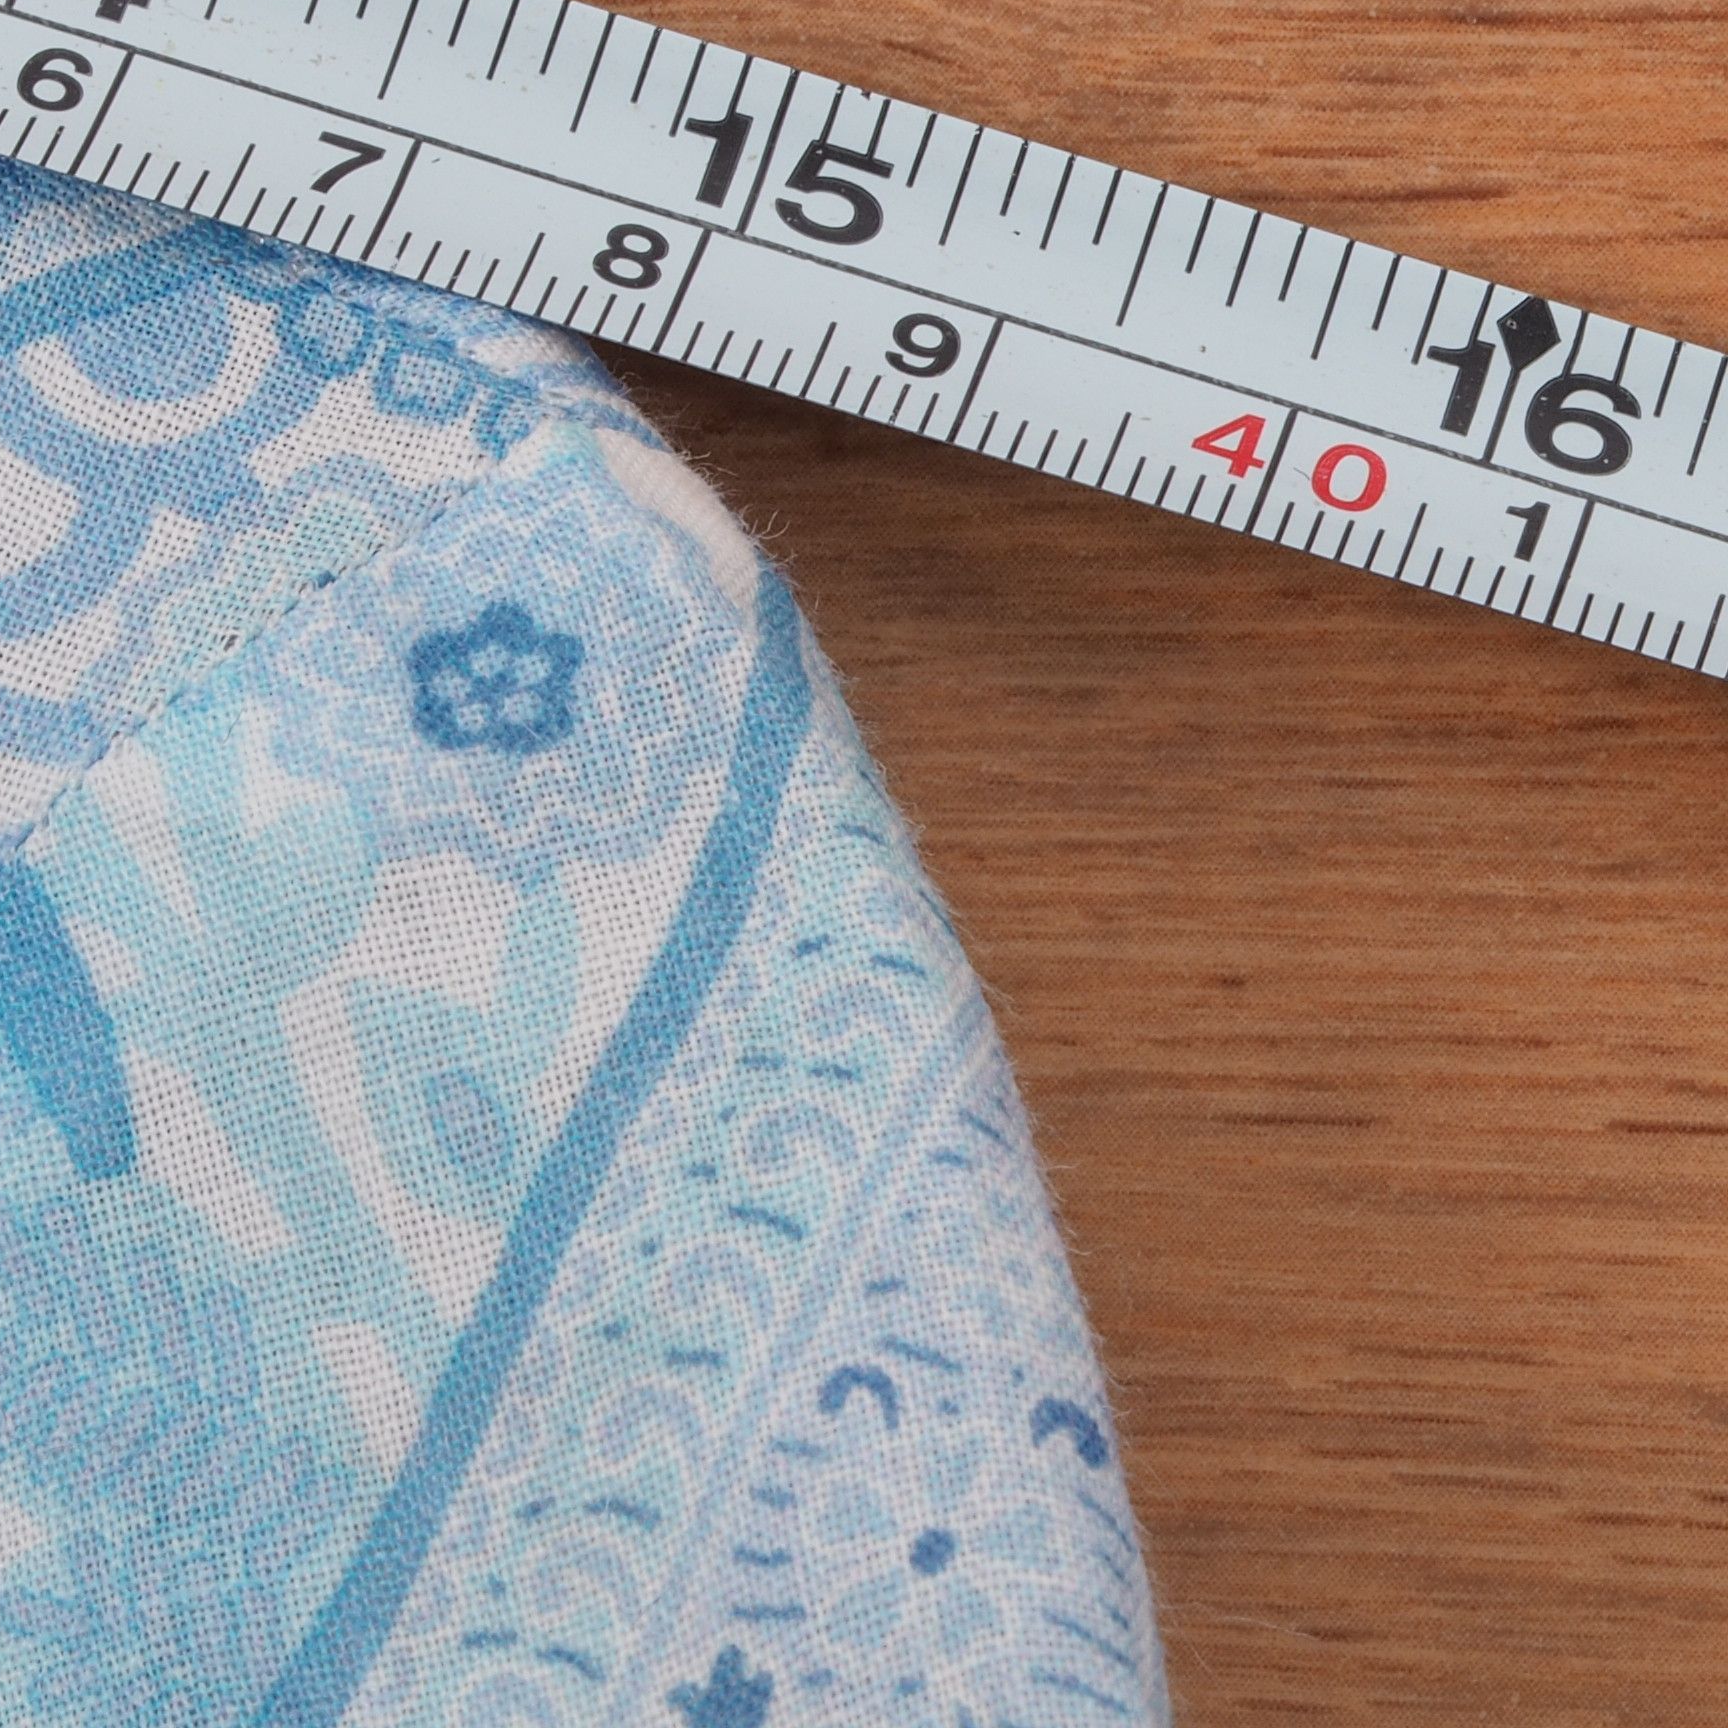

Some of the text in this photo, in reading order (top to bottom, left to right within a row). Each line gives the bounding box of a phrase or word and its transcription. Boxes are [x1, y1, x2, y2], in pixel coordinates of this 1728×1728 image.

[15, 47, 94, 112] 6
[308, 132, 385, 195] 7
[683, 109, 895, 245] 15
[591, 224, 670, 289] 8
[885, 313, 960, 379] 9
[1427, 335, 1642, 475] 16
[1191, 413, 1389, 512] 40
[1505, 501, 1551, 562] 1
